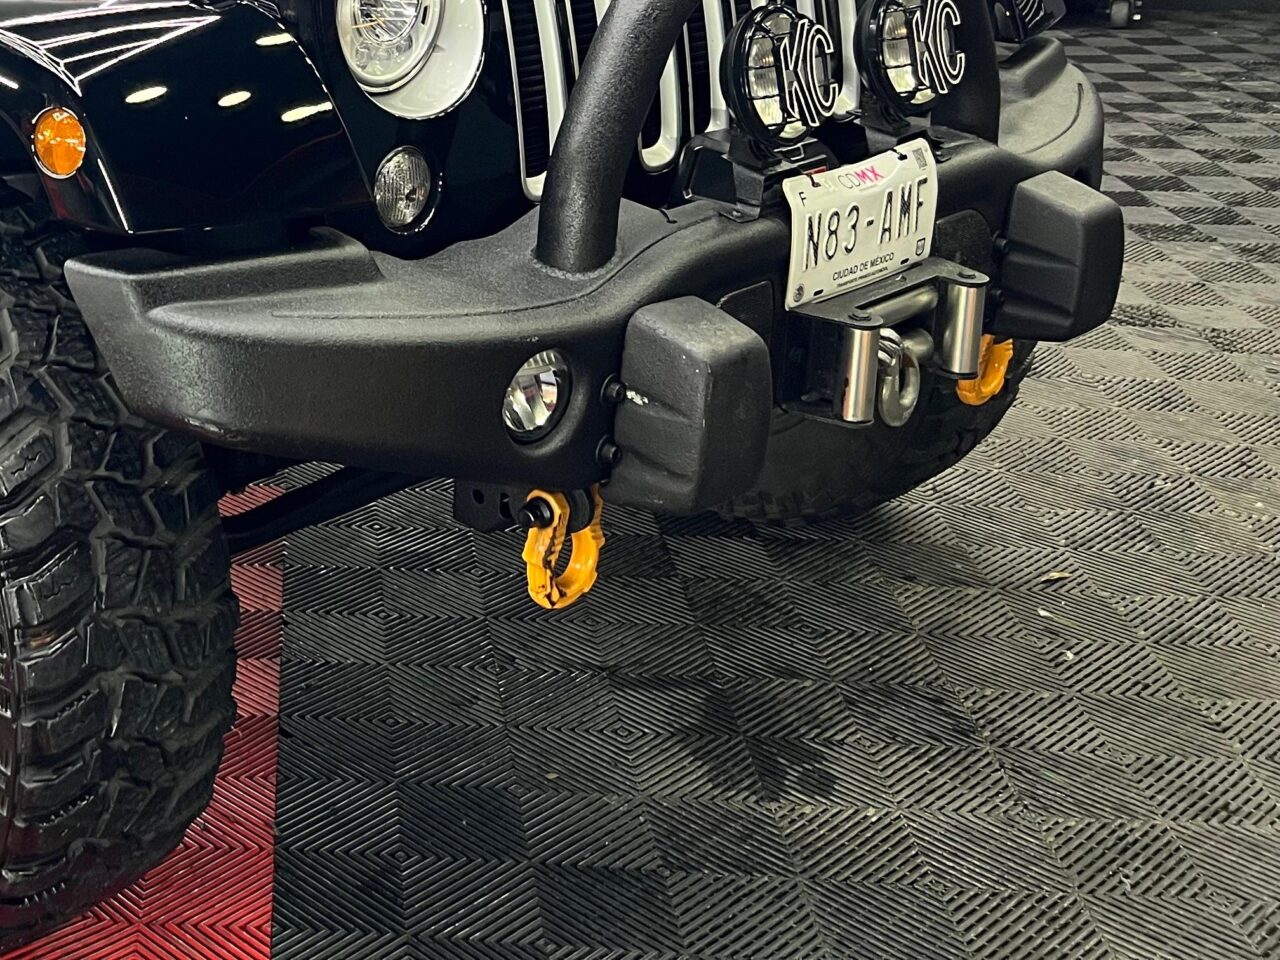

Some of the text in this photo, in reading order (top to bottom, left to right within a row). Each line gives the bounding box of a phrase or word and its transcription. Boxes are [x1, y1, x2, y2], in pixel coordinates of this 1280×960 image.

[780, 19, 839, 127] KC
[837, 165, 884, 190] CDMX
[803, 177, 929, 272] N83-AMF
[832, 251, 895, 281] CIUDAD DE MÉXICO
